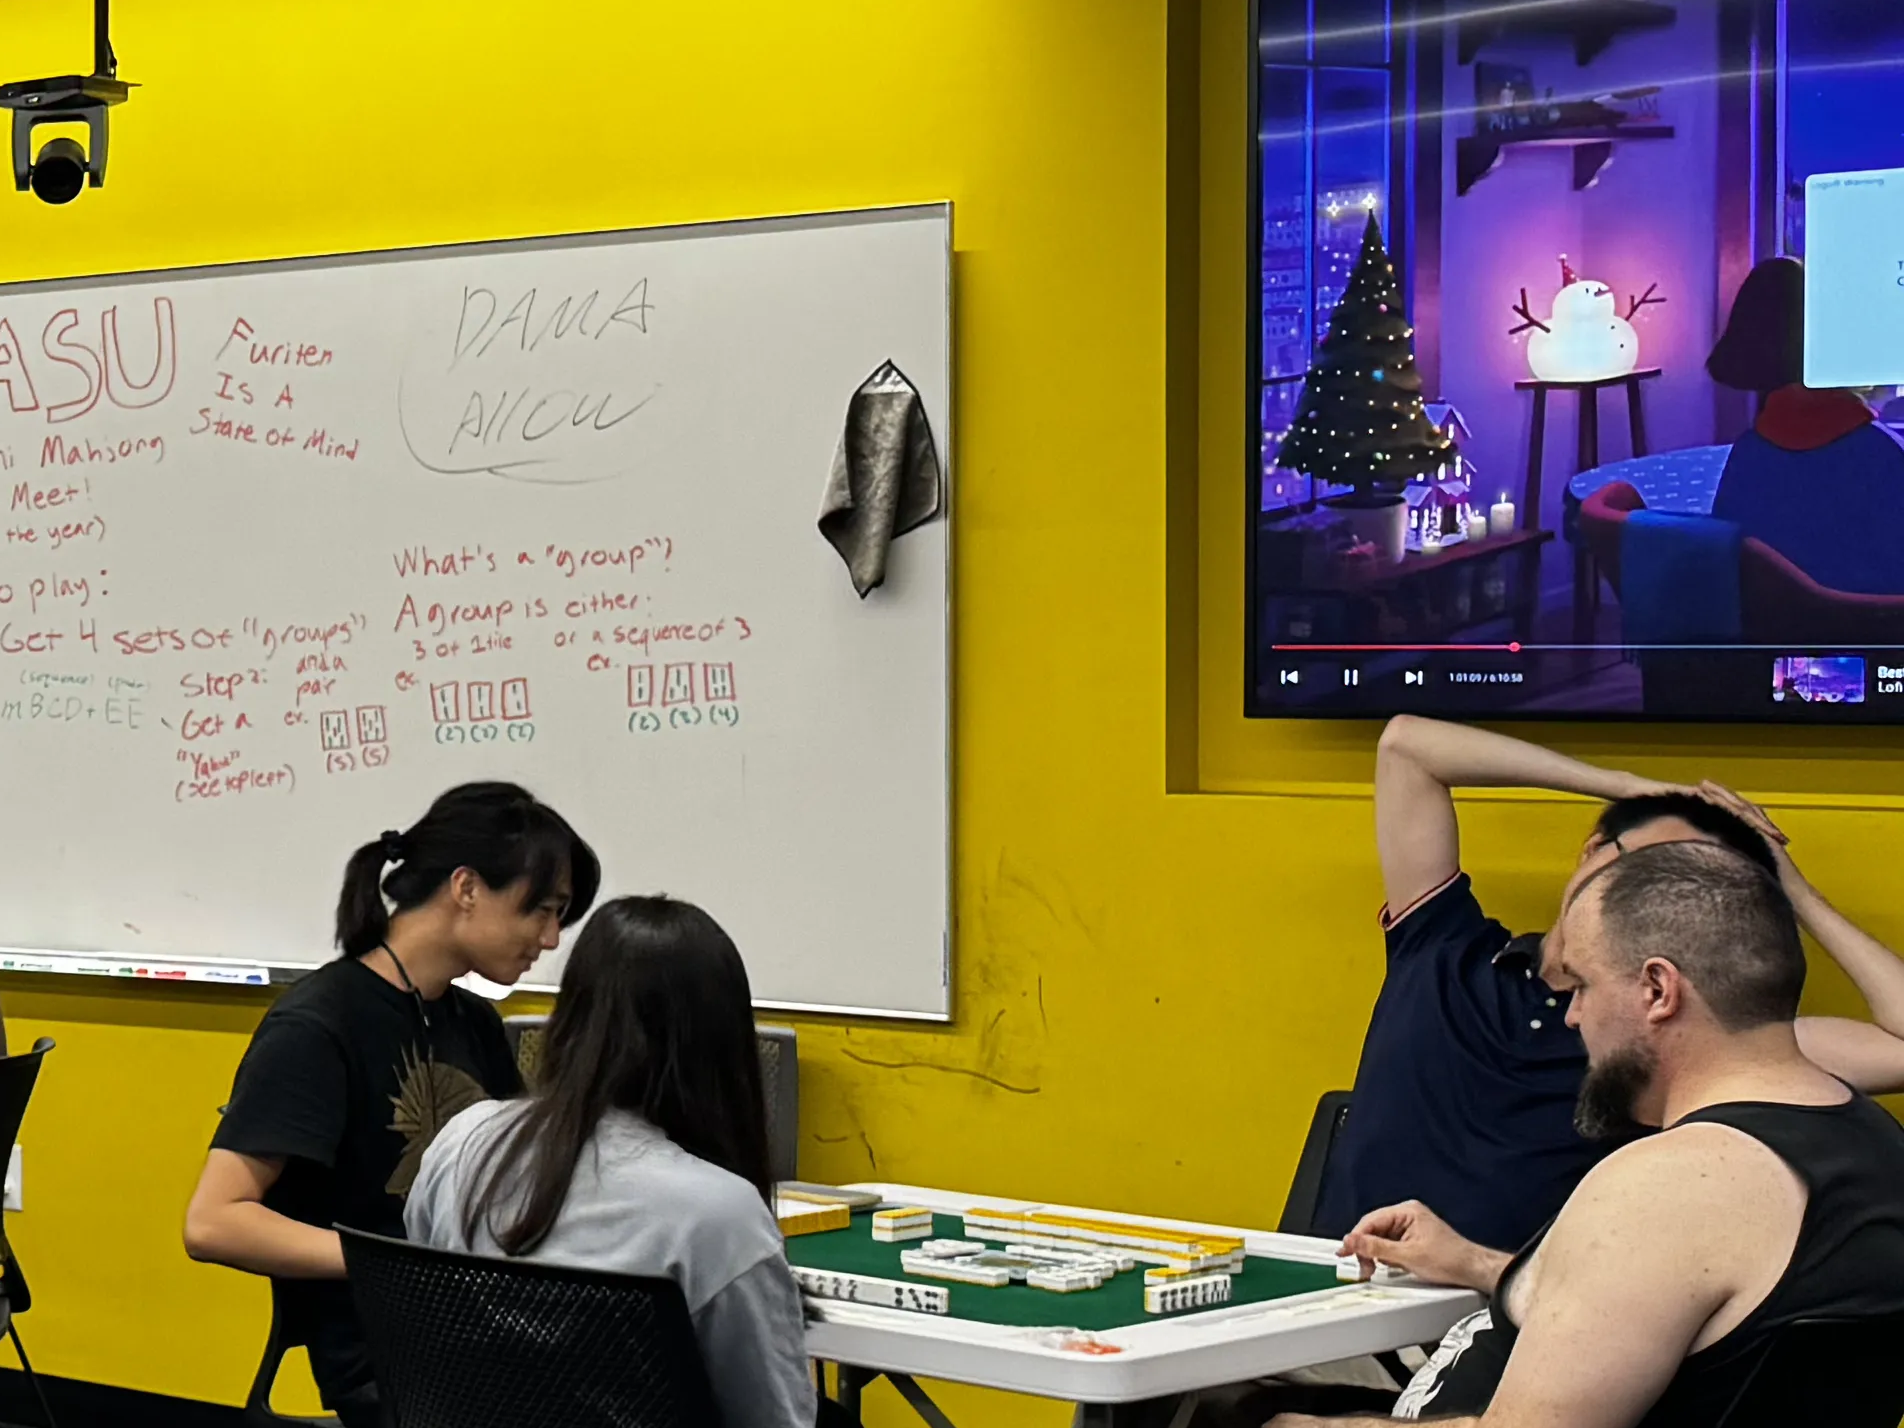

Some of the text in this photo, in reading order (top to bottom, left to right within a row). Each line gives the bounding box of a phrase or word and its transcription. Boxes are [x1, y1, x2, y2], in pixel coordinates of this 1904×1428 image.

[275, 387, 294, 410] A
[40, 433, 166, 472] Mahjong
[303, 429, 363, 462] Mind
[5, 521, 40, 545] the
[393, 544, 497, 578] What's
[517, 551, 536, 566] a
[394, 593, 419, 633] A
[428, 599, 514, 636] group
[0, 622, 64, 655] Get
[78, 618, 100, 654] 4
[113, 625, 186, 655] sets
[191, 622, 234, 649] of
[412, 638, 427, 660] 3
[734, 616, 752, 641] 3
[295, 677, 338, 707] pair
[180, 708, 254, 741] Get a
